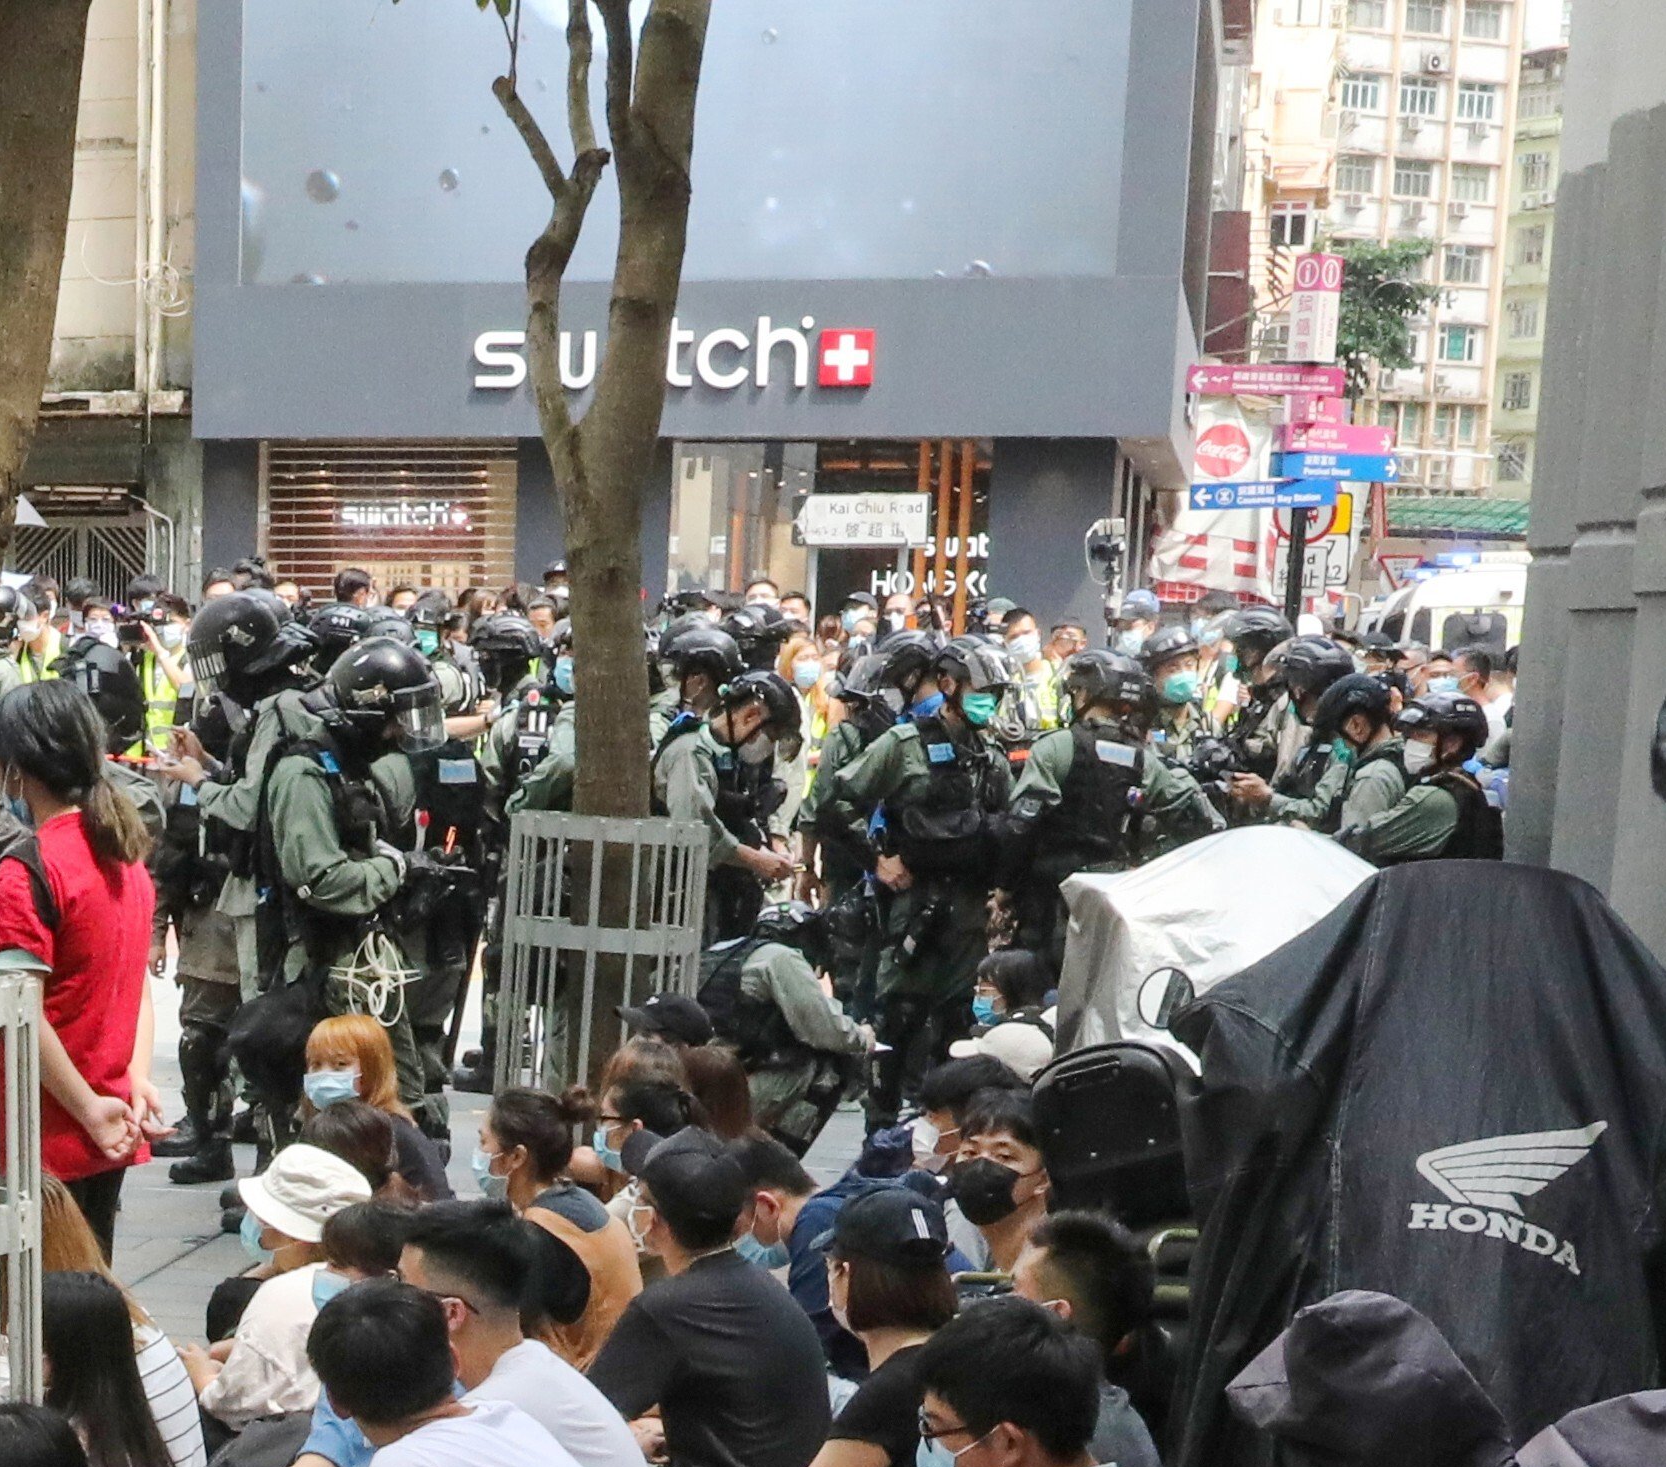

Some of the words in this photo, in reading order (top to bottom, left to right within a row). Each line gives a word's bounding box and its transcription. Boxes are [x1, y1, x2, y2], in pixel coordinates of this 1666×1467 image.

[474, 315, 815, 389] swtch
[829, 502, 850, 515] Kai
[854, 499, 885, 514] Chiu
[889, 501, 923, 515] Rad
[1407, 1201, 1582, 1277] HONDA
